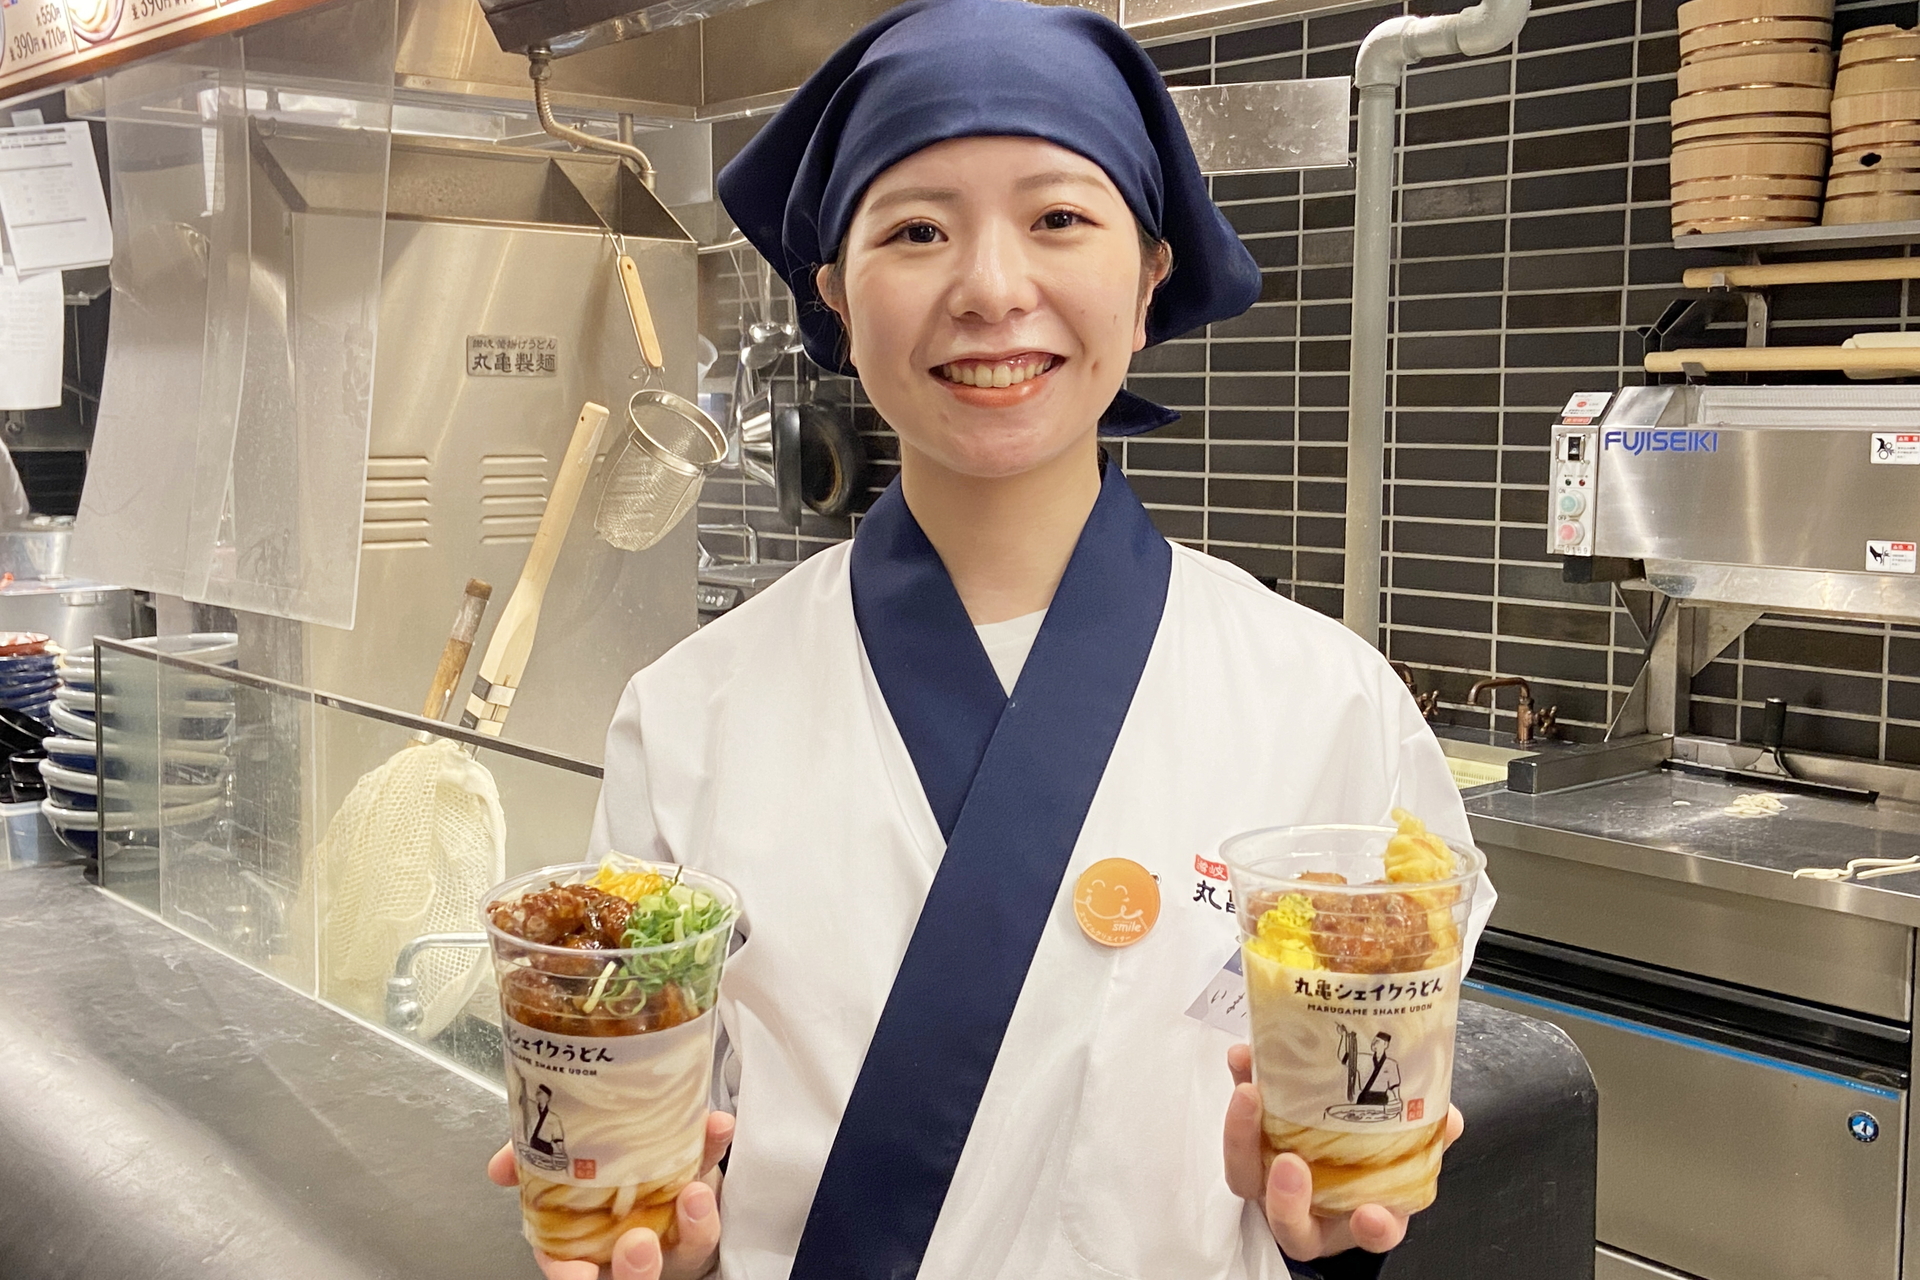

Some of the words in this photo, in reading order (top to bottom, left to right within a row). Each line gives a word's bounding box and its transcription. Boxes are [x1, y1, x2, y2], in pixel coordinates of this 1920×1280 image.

[472, 352, 556, 373] 丸亀製麺
[1604, 431, 1718, 456] FUJISEIKI
[1079, 910, 1132, 943] スマイルクリエイター
[1112, 921, 1142, 933] smile
[1294, 976, 1443, 1001] 丸亀シェイクうどん
[1307, 1003, 1368, 1016] MARUGAME
[1372, 1005, 1406, 1016] SHAKE
[1409, 1002, 1433, 1013] UDON
[535, 1061, 565, 1074] SHAKE
